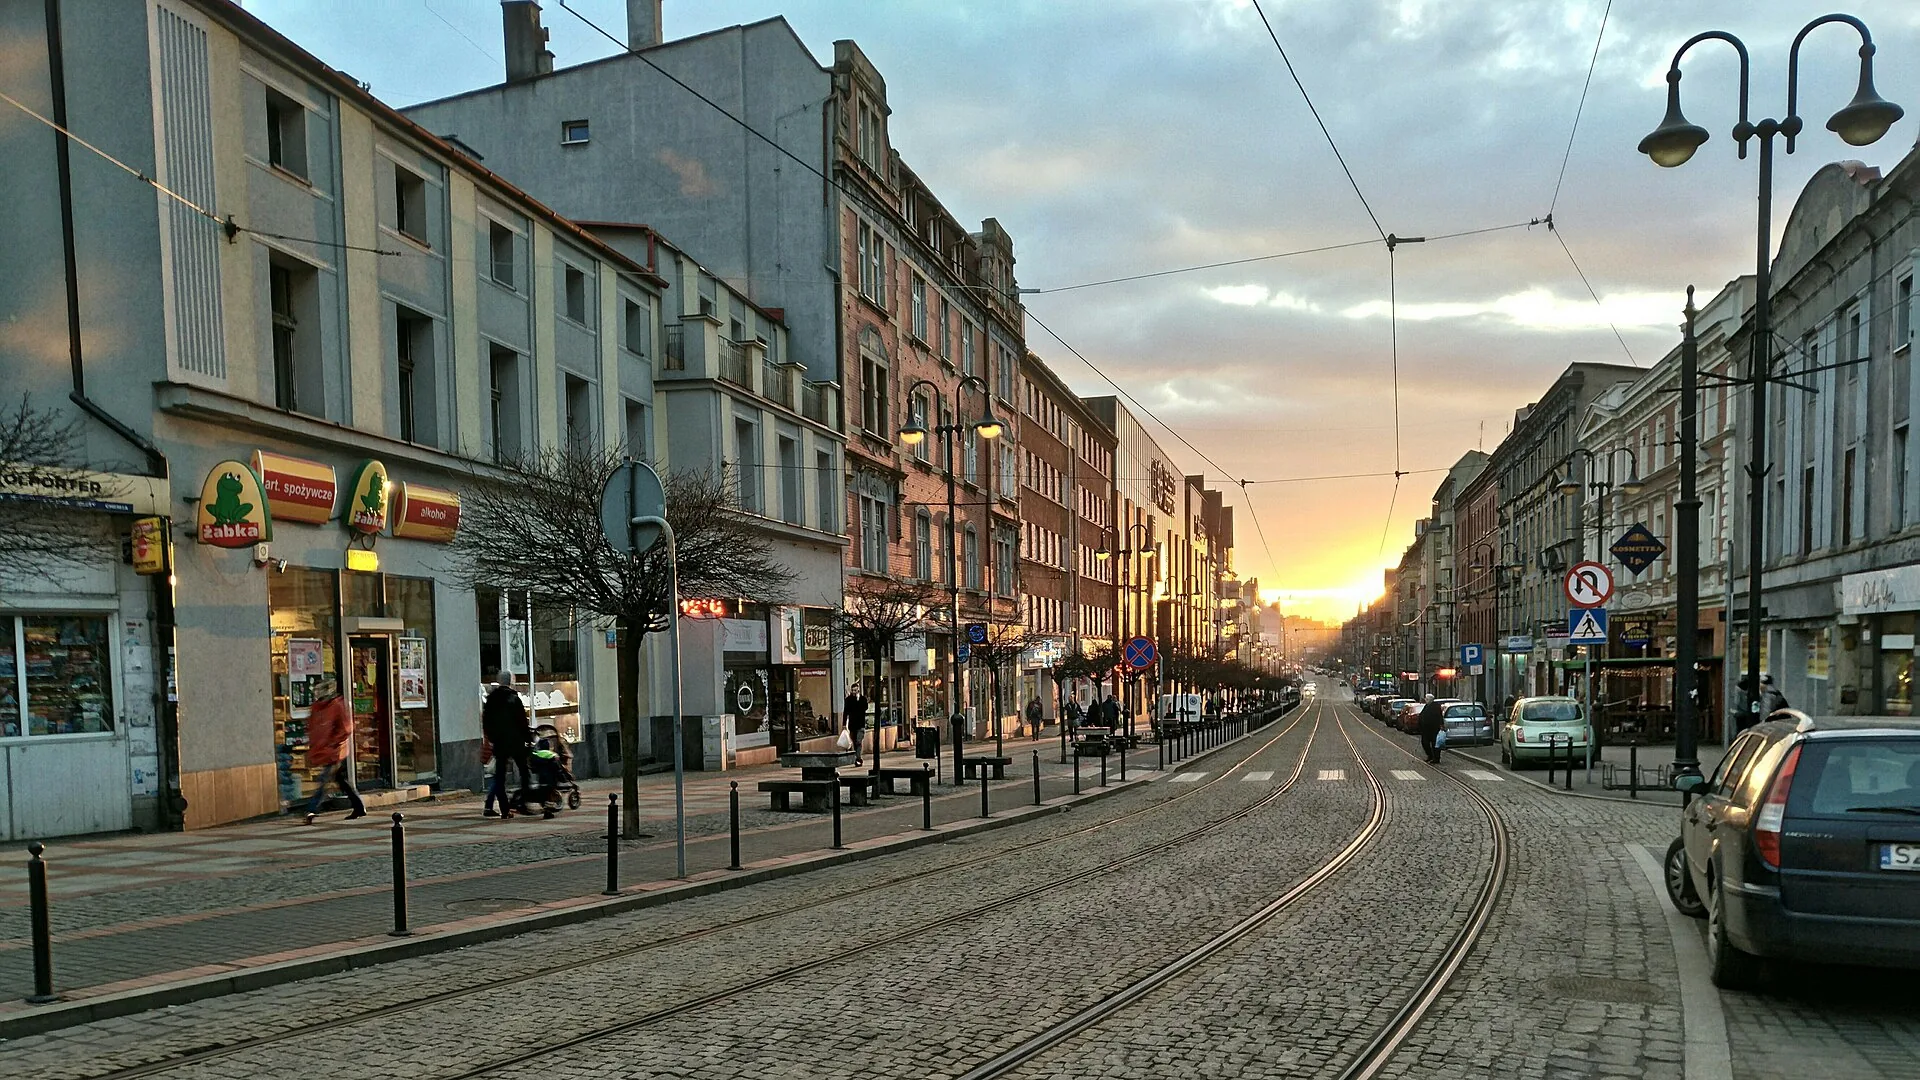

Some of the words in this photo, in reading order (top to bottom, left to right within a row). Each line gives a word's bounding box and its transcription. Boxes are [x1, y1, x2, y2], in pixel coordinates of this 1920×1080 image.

[265, 480, 281, 492] art.
[283, 483, 333, 500] spożywcze
[355, 513, 384, 526] żabka
[203, 524, 259, 539] żabka
[1612, 545, 1662, 553] KOSMETYKA
[1465, 646, 1478, 663] P
